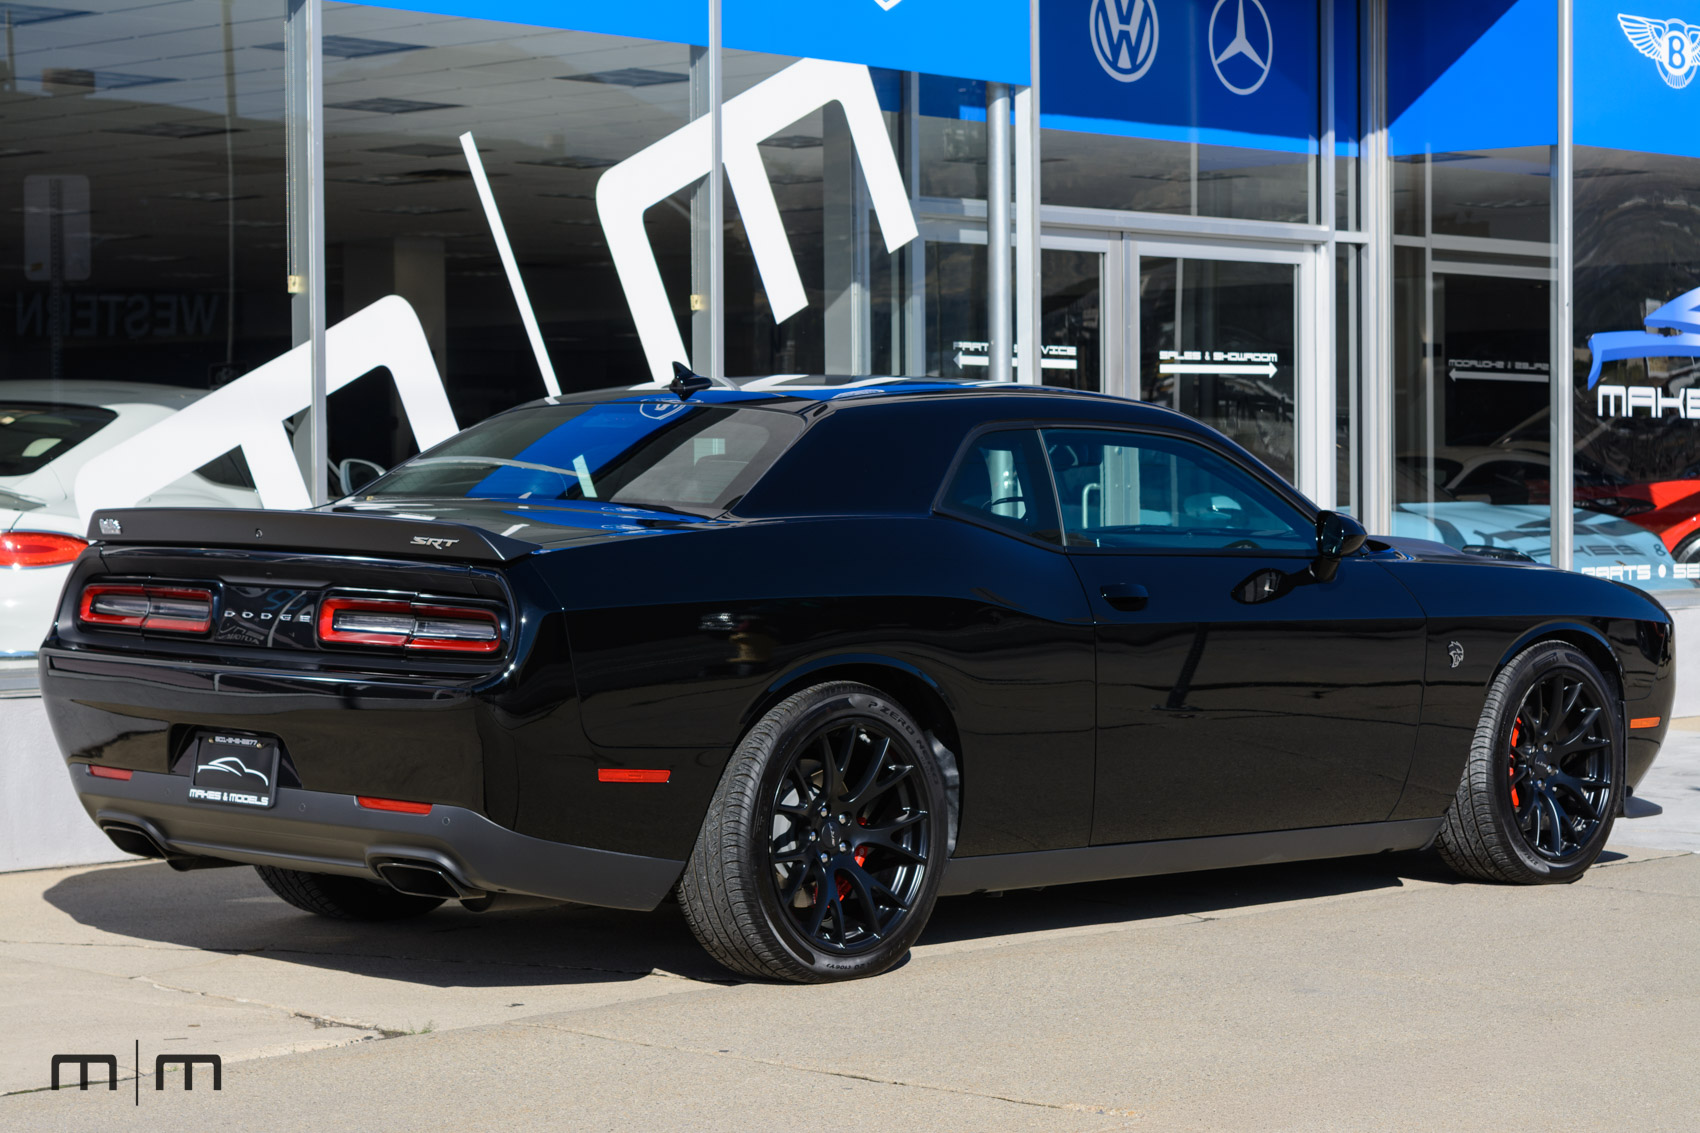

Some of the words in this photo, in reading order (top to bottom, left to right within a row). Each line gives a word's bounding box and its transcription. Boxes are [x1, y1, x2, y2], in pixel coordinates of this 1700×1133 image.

[1159, 350, 1202, 361] SALES
[1212, 351, 1278, 363] SHOWROOM
[410, 536, 460, 550] SRT
[223, 610, 311, 623] DODGE
[880, 705, 916, 736] ZERO
[189, 788, 222, 801] MAKES
[222, 792, 228, 802] &
[228, 793, 269, 807] MODELS
